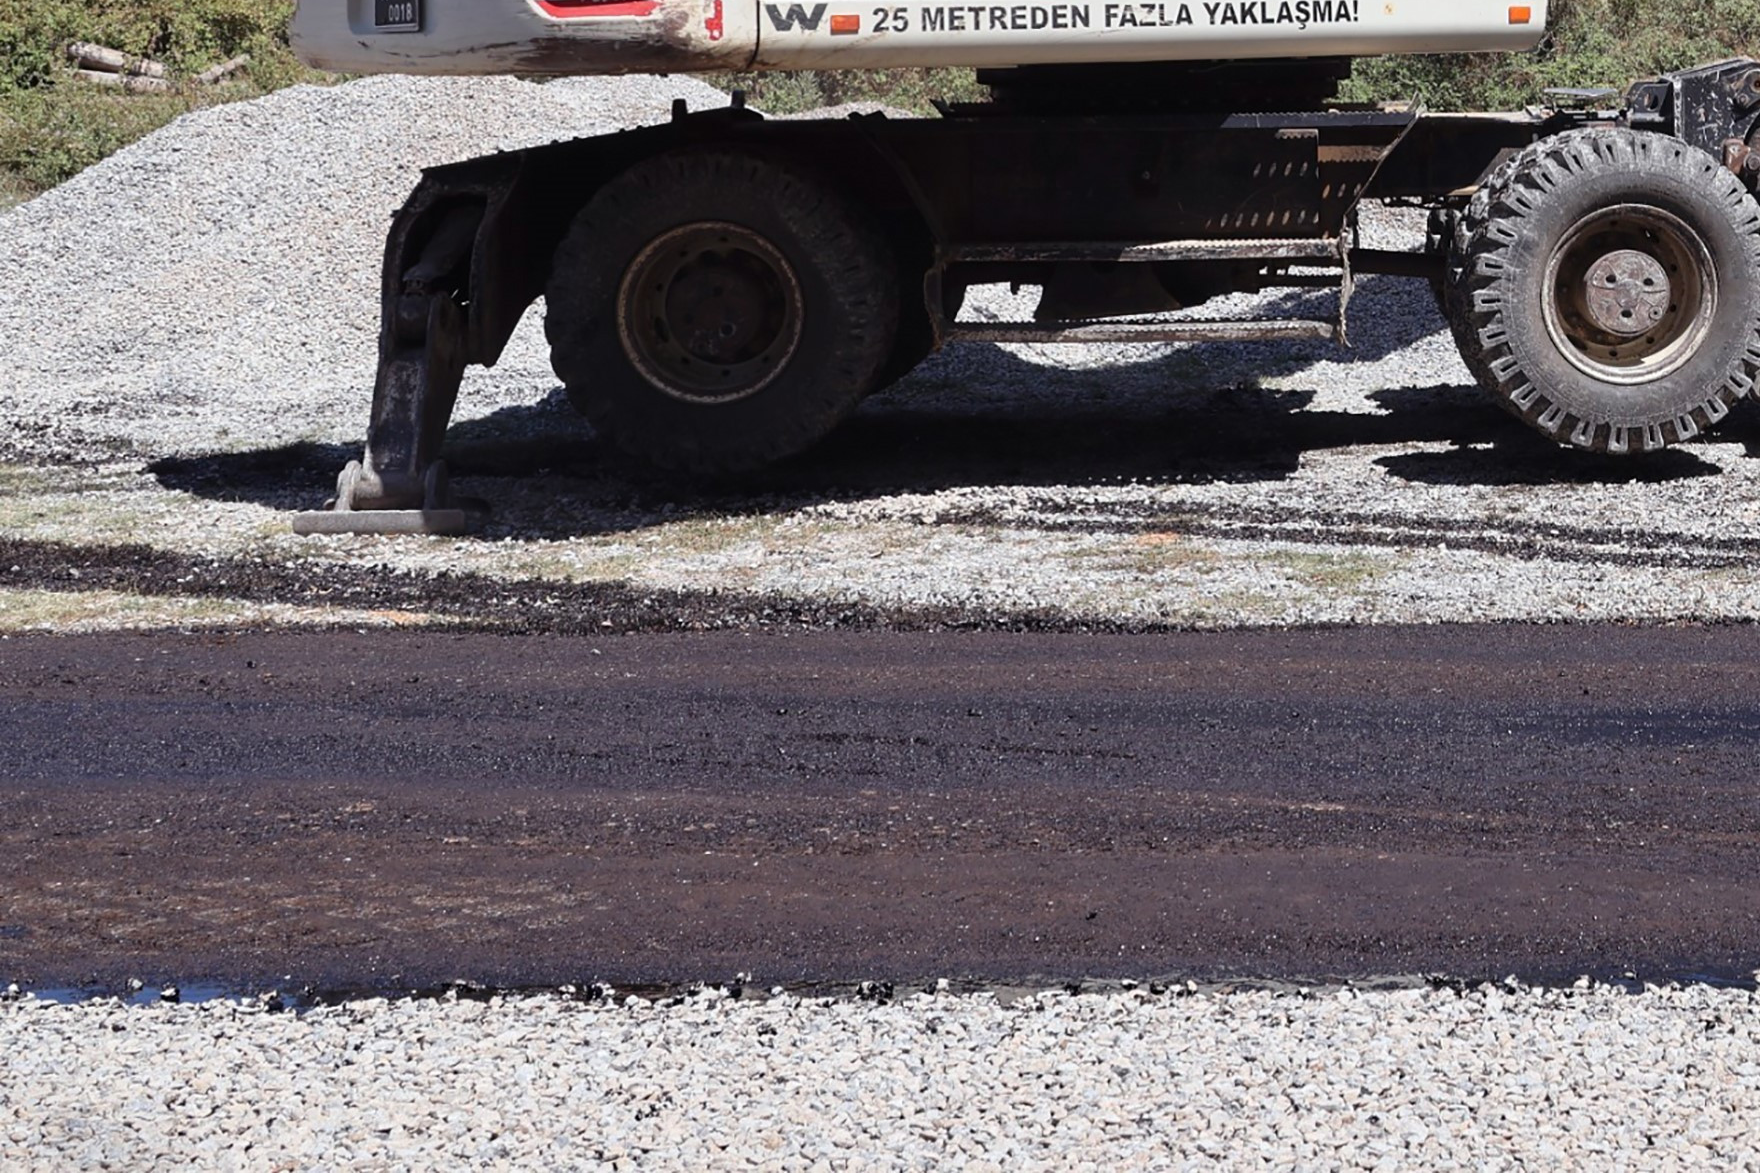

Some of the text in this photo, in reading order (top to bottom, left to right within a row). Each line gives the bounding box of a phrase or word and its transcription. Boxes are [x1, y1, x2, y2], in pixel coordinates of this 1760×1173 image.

[765, 3, 828, 31] W
[872, 0, 1359, 33] 25 METREDEN FAZLA YAKLAŞMA!
